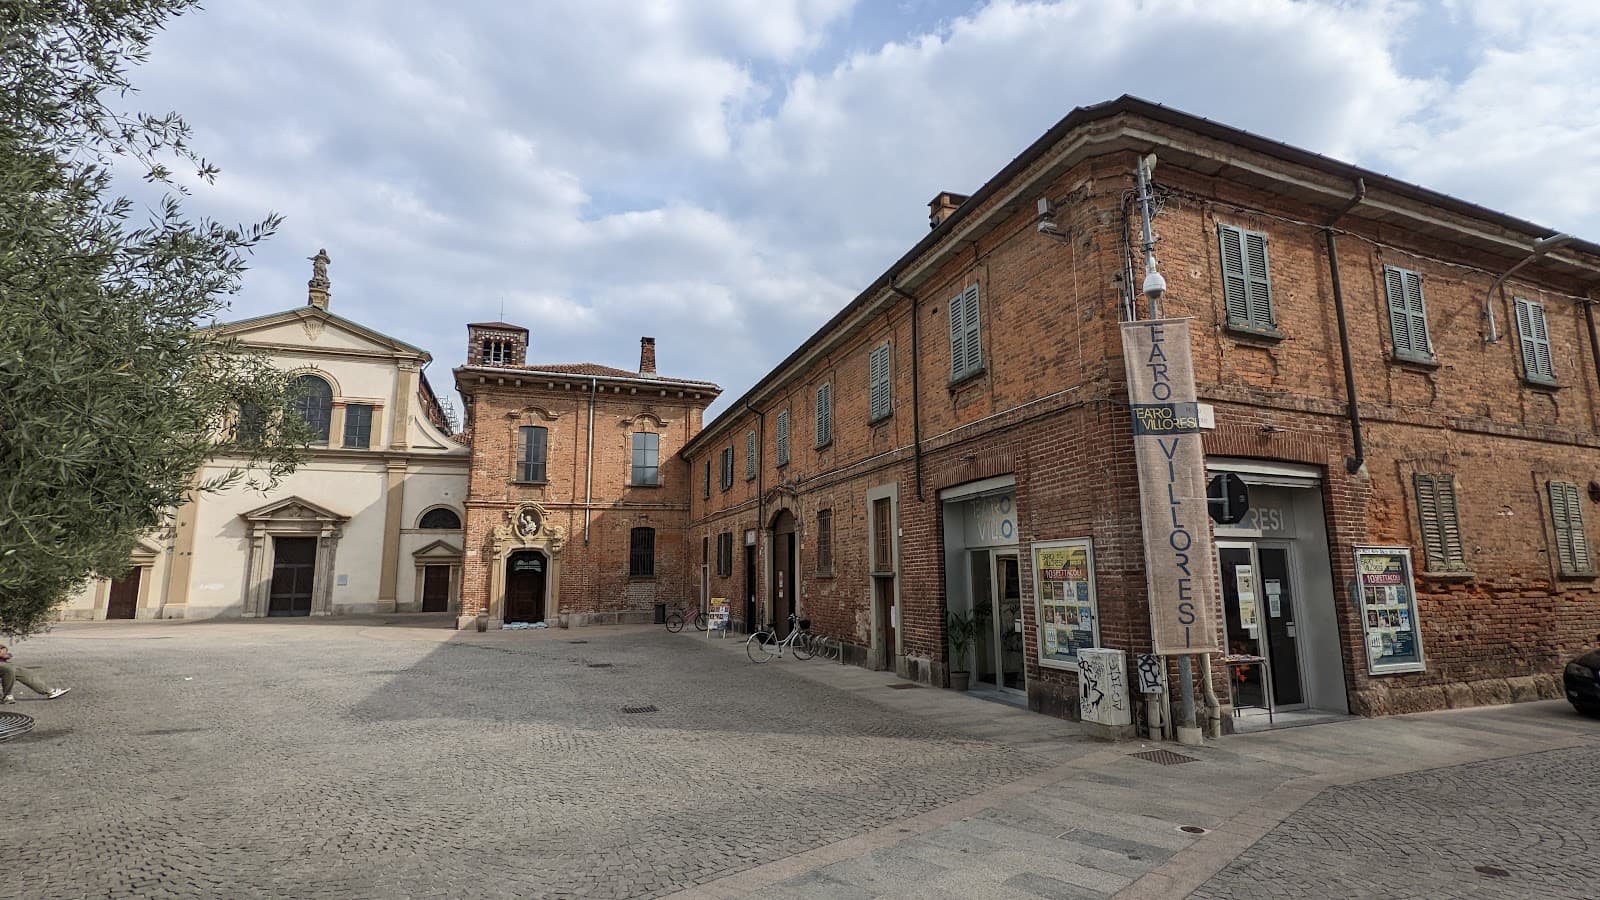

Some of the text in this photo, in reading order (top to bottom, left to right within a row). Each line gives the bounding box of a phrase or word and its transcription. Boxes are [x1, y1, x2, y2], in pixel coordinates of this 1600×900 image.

[1132, 407, 1173, 419] TEATRO
[1142, 416, 1198, 431] VILLORESI
[1157, 438, 1195, 649] VILLORESI
[1366, 574, 1376, 584] 10
